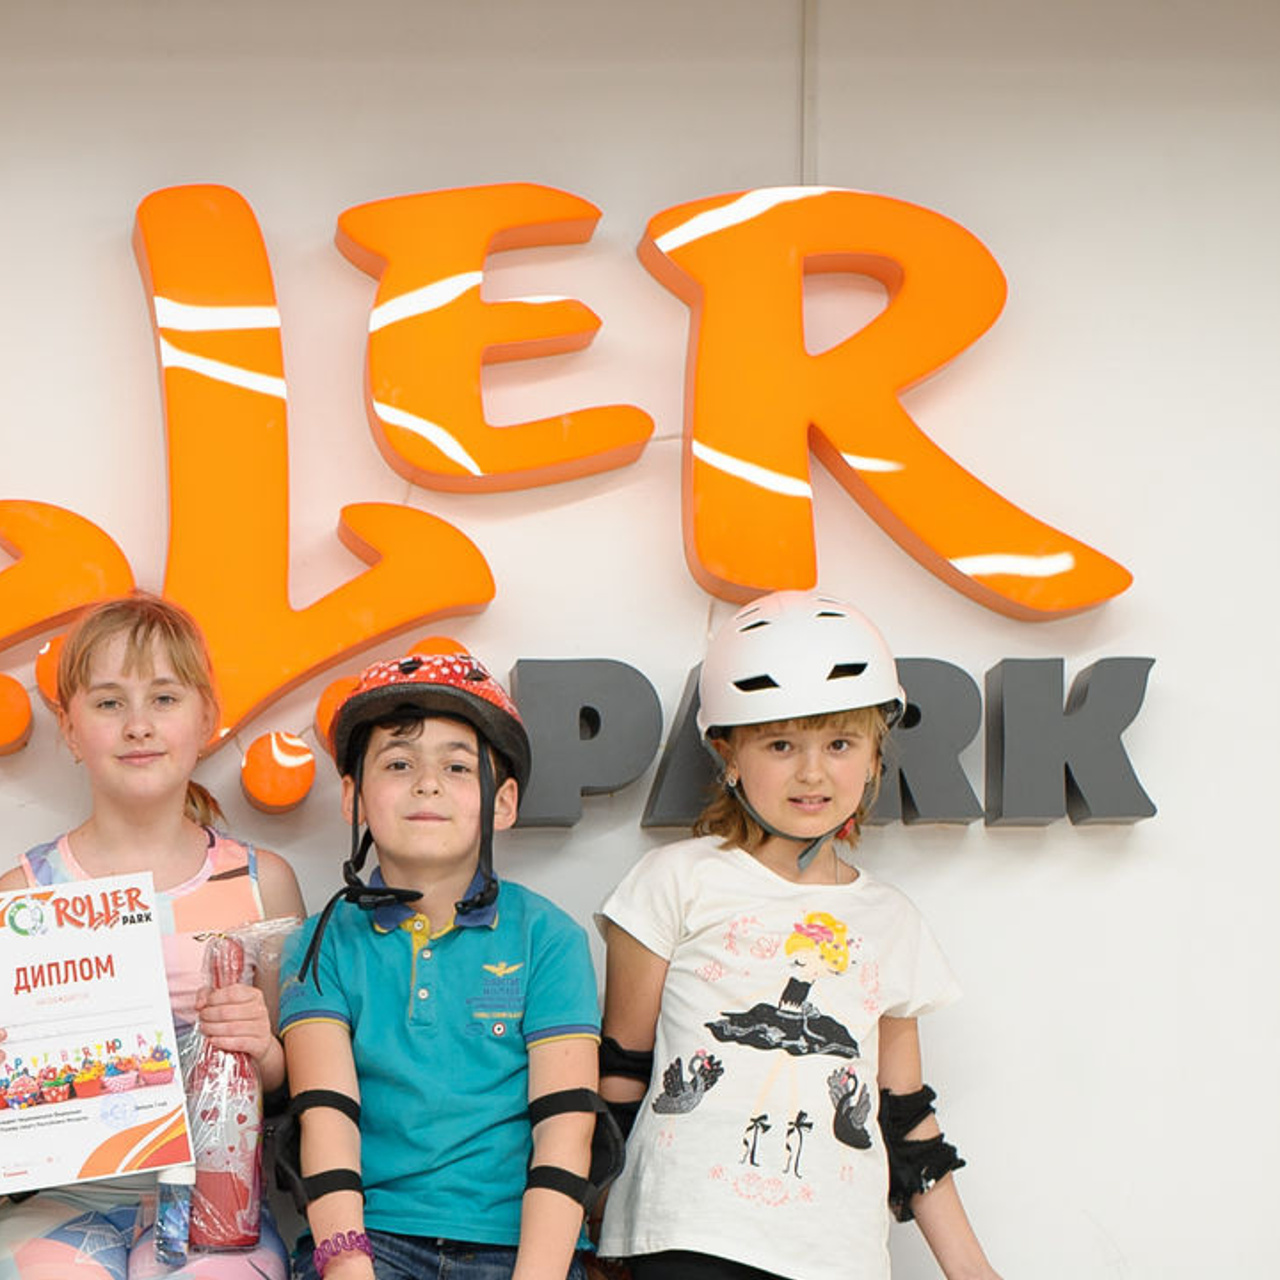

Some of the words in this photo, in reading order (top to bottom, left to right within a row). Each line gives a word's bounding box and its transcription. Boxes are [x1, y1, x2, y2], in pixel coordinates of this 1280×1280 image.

[52, 887, 150, 930] ROLLER
[122, 911, 153, 926] PARK
[14, 953, 115, 995] ДИПЛОМ
